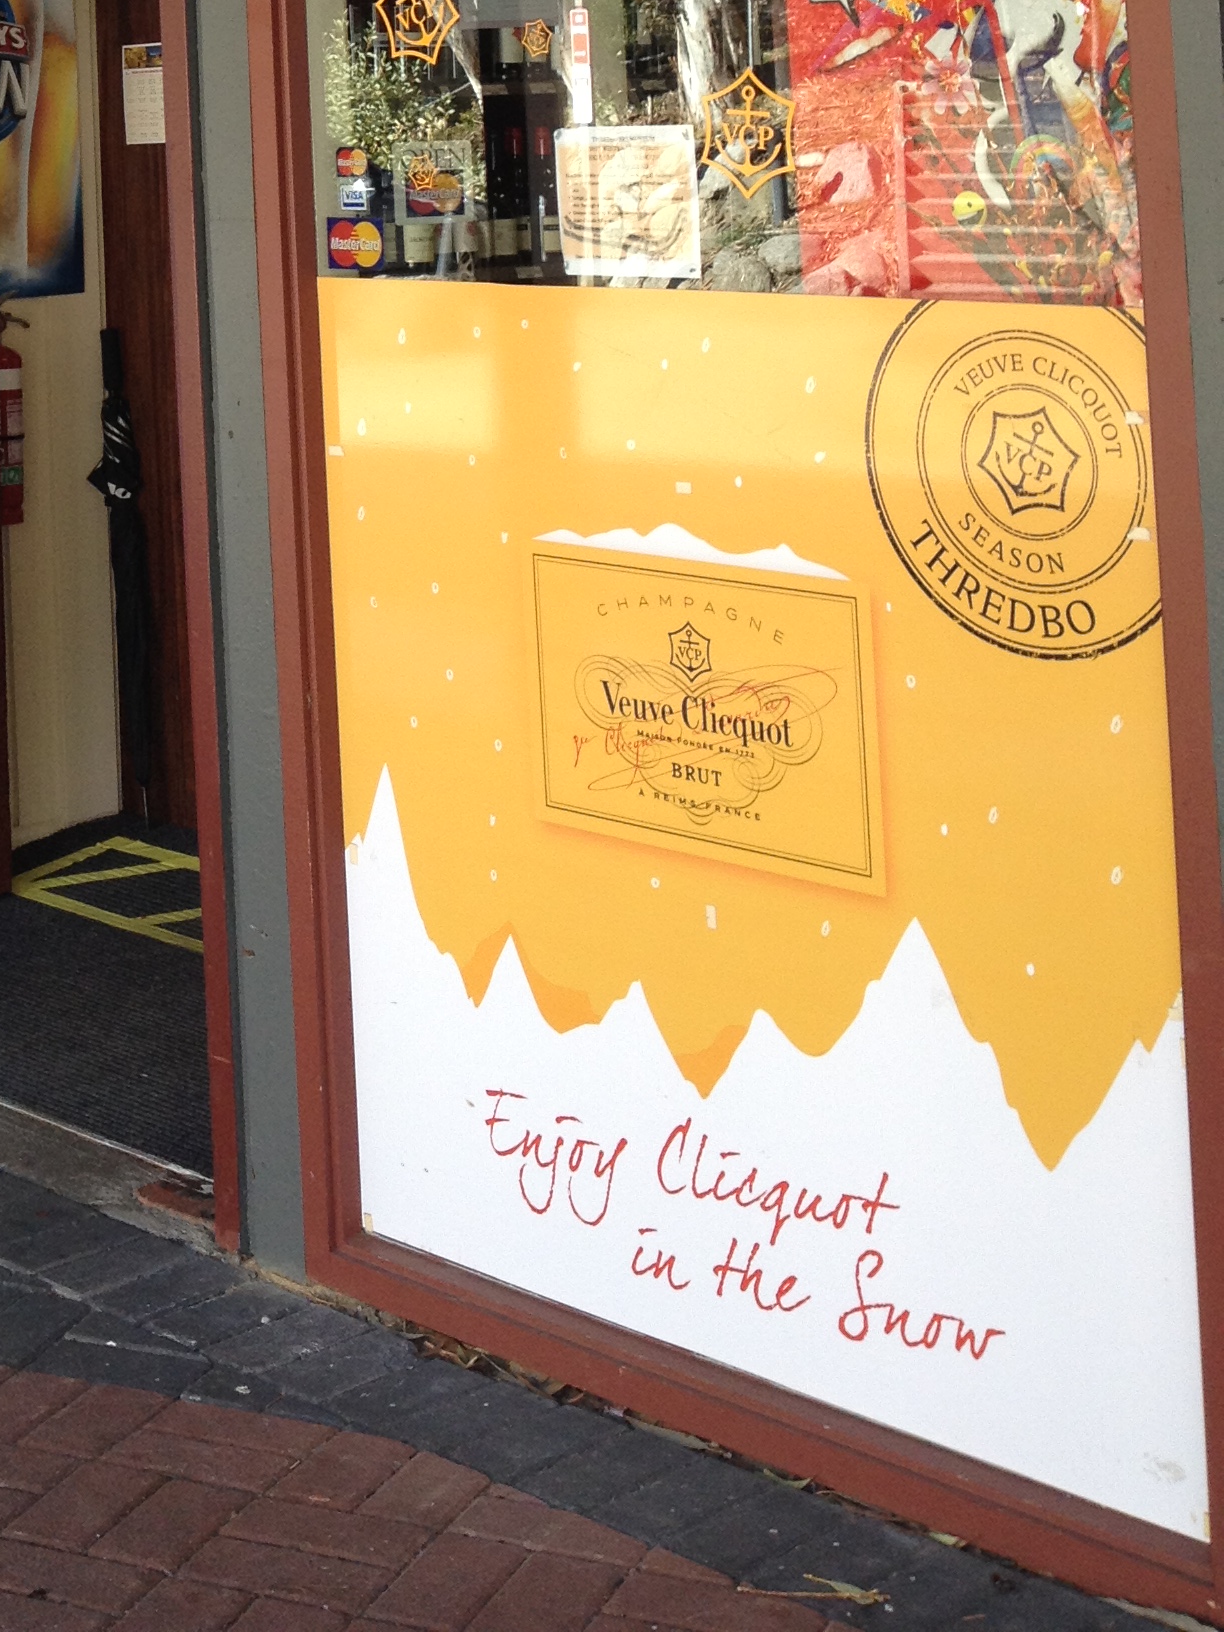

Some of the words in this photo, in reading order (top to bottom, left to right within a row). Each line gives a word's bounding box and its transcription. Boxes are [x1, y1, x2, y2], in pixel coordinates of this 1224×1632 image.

[721, 122, 775, 150] VCP
[344, 190, 364, 200] VISA
[330, 237, 382, 251] MasterCard
[953, 352, 1024, 399] VEUVE
[1032, 355, 1123, 459] CLICQUOT
[958, 511, 1066, 575] SEASON
[909, 518, 1097, 639] THREDBO
[596, 594, 785, 646] CHAMPAGNE
[677, 645, 702, 661] VCP
[600, 679, 675, 726] Veuve
[681, 694, 795, 748] Clicquot
[653, 791, 697, 808] REIMS
[671, 762, 723, 788] BRUT
[484, 1088, 629, 1227] Enjoy
[657, 1117, 901, 1246] Clicquot
[630, 1227, 691, 1290] in
[712, 1237, 812, 1312] the
[837, 1249, 1006, 1361] Snow
